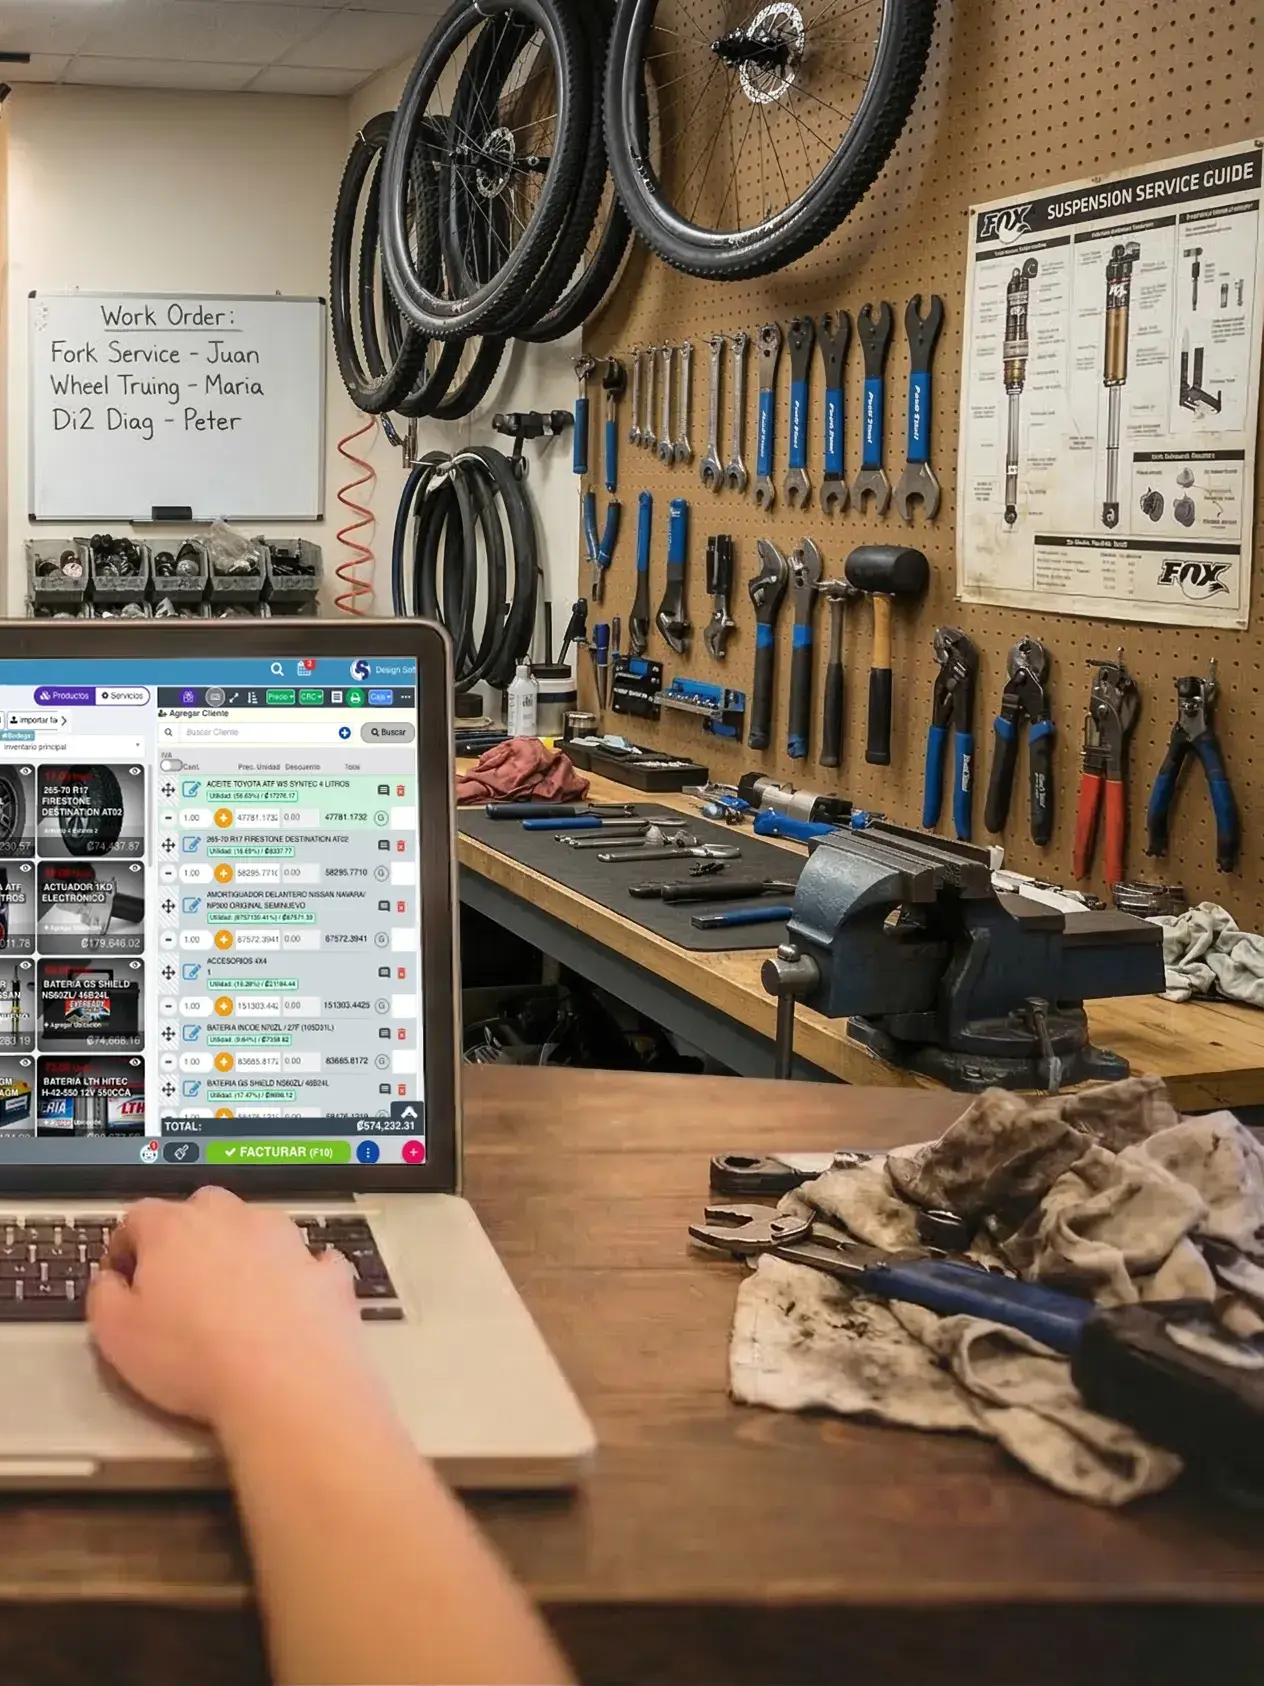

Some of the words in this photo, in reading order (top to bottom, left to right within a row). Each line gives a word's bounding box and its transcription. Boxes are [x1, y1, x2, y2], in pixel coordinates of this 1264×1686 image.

[981, 204, 1033, 243] FOX
[1047, 187, 1133, 220] SUSPENSION
[1136, 173, 1200, 202] SERVICE
[1203, 161, 1255, 189] GUIDE
[100, 305, 157, 326] Work
[167, 303, 235, 326] Order:
[51, 340, 99, 363] Fork
[108, 340, 181, 364] Service
[206, 340, 260, 364] Juan
[50, 373, 109, 396] Wheel
[117, 374, 180, 405] Truing
[205, 373, 265, 396] Maria
[52, 408, 94, 431] Di2
[107, 407, 154, 440] Diag
[184, 407, 242, 431] Peter
[1157, 558, 1232, 600] FOX
[375, 665, 401, 676] Design
[52, 691, 89, 700] Productos
[110, 691, 144, 700] Servicios
[169, 709, 201, 719] Agregar
[202, 709, 229, 717] Cliente
[381, 728, 406, 736] Buscar
[38, 743, 67, 752] principal
[44, 786, 70, 794] 265-70
[72, 786, 88, 794] R17
[42, 797, 91, 805] FIRESTONE
[42, 808, 100, 816] DESTINATION
[101, 808, 123, 816] AT02
[283, 813, 300, 821] 0.00
[5, 883, 22, 892] ATF
[43, 883, 93, 892] ACTUADOR
[95, 883, 113, 892] 1KD
[42, 894, 105, 902] ELECTRONICO
[43, 980, 82, 989] BATERIA
[83, 980, 97, 989] GS
[98, 980, 130, 989] SHIELD
[43, 1077, 81, 1086] BATERIA
[83, 1077, 100, 1086] LTH
[101, 1077, 128, 1086] HITEC
[42, 1089, 78, 1097] H-42-550
[80, 1089, 96, 1097] 12V
[97, 1089, 132, 1097] 550CCA
[165, 1121, 202, 1131] TOTAL:
[240, 1147, 306, 1157] FACTURAR
[309, 1147, 333, 1158] (F10)
